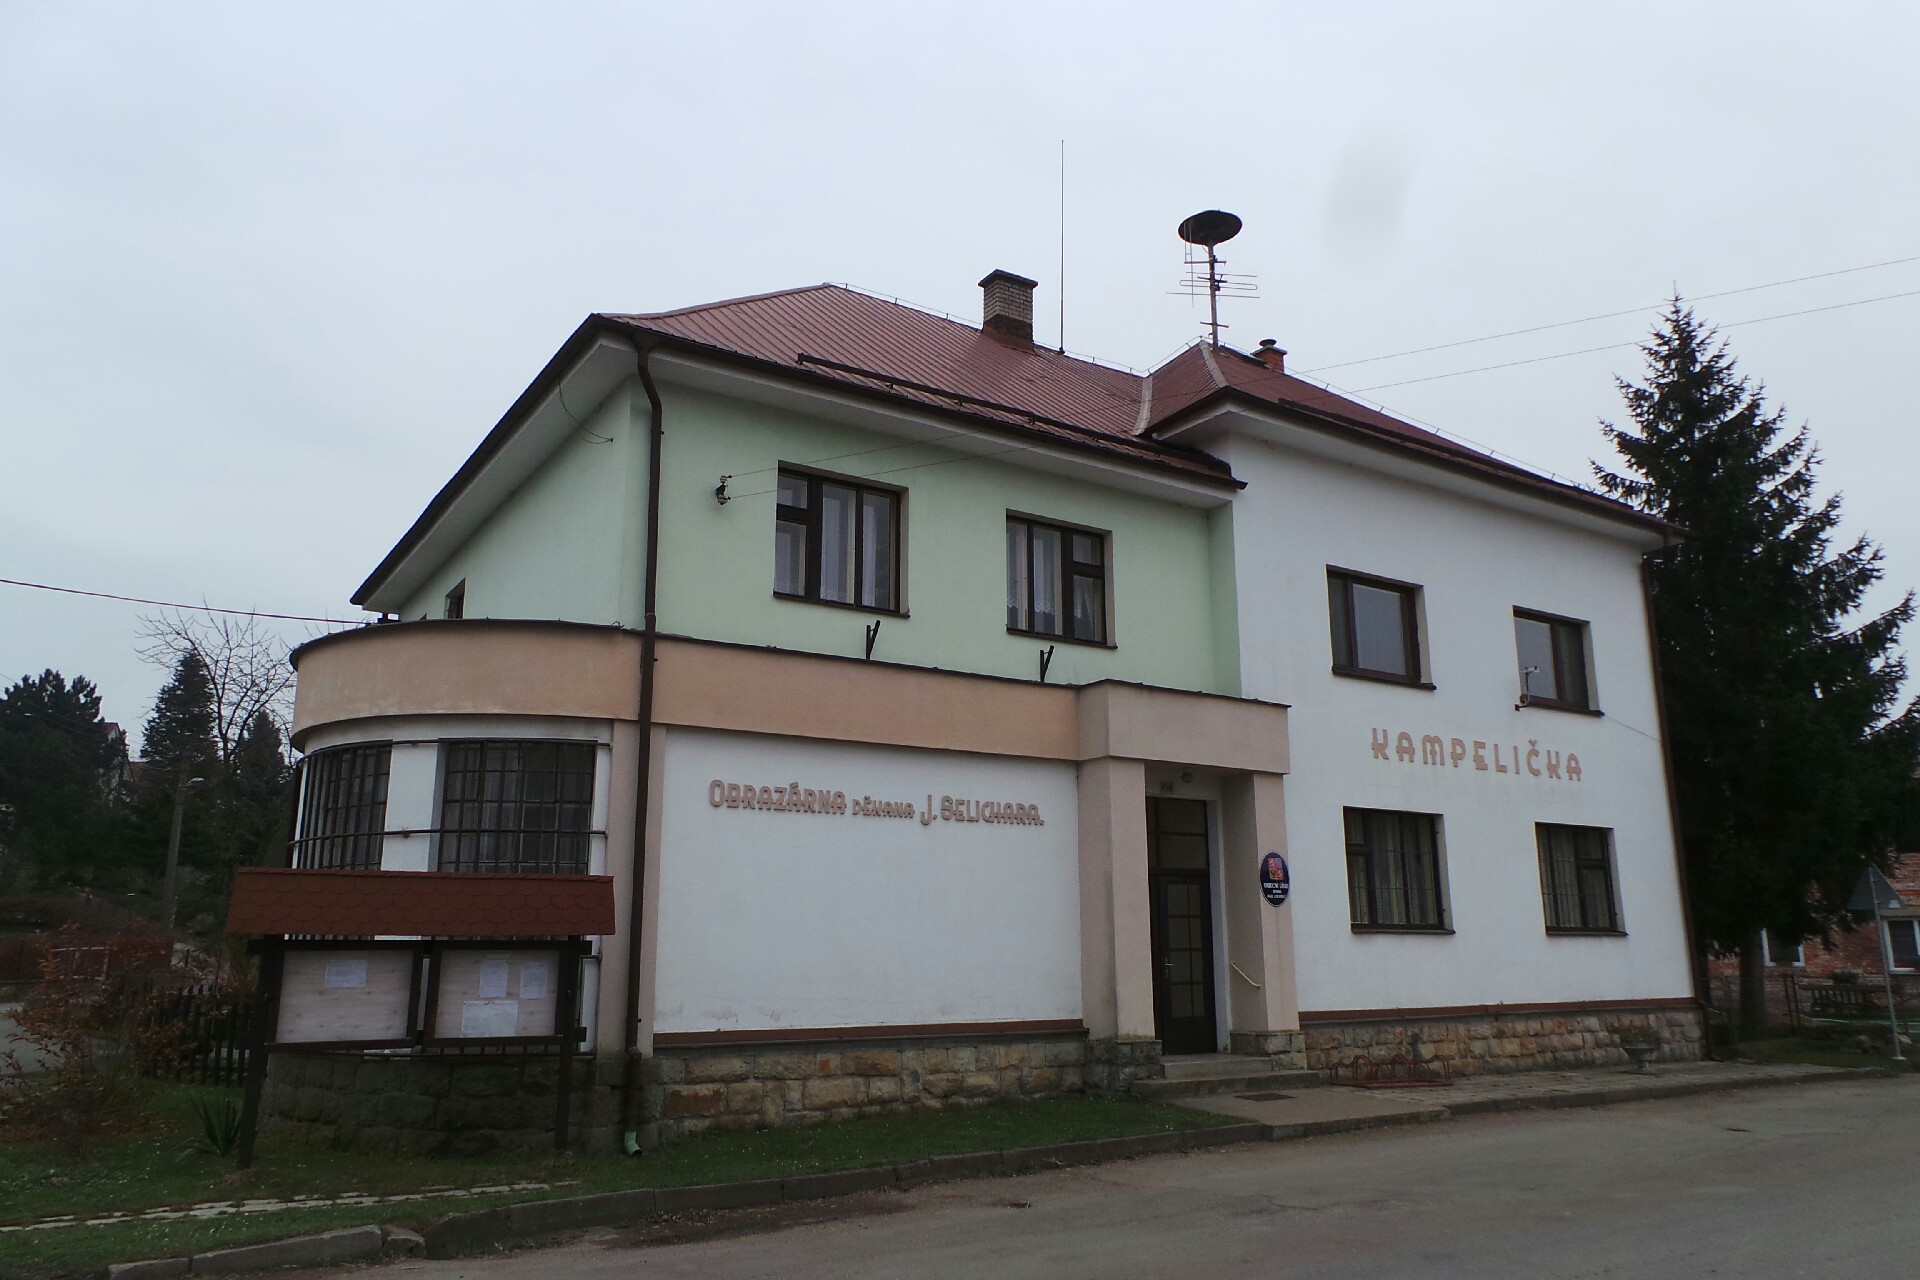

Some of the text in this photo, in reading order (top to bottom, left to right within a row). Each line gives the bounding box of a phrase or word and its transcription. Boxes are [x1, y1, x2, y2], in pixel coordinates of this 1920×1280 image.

[1371, 728, 1582, 781] KAMPELIČKA
[709, 779, 847, 814] OBRAZÁRNA
[920, 795, 937, 825] J.
